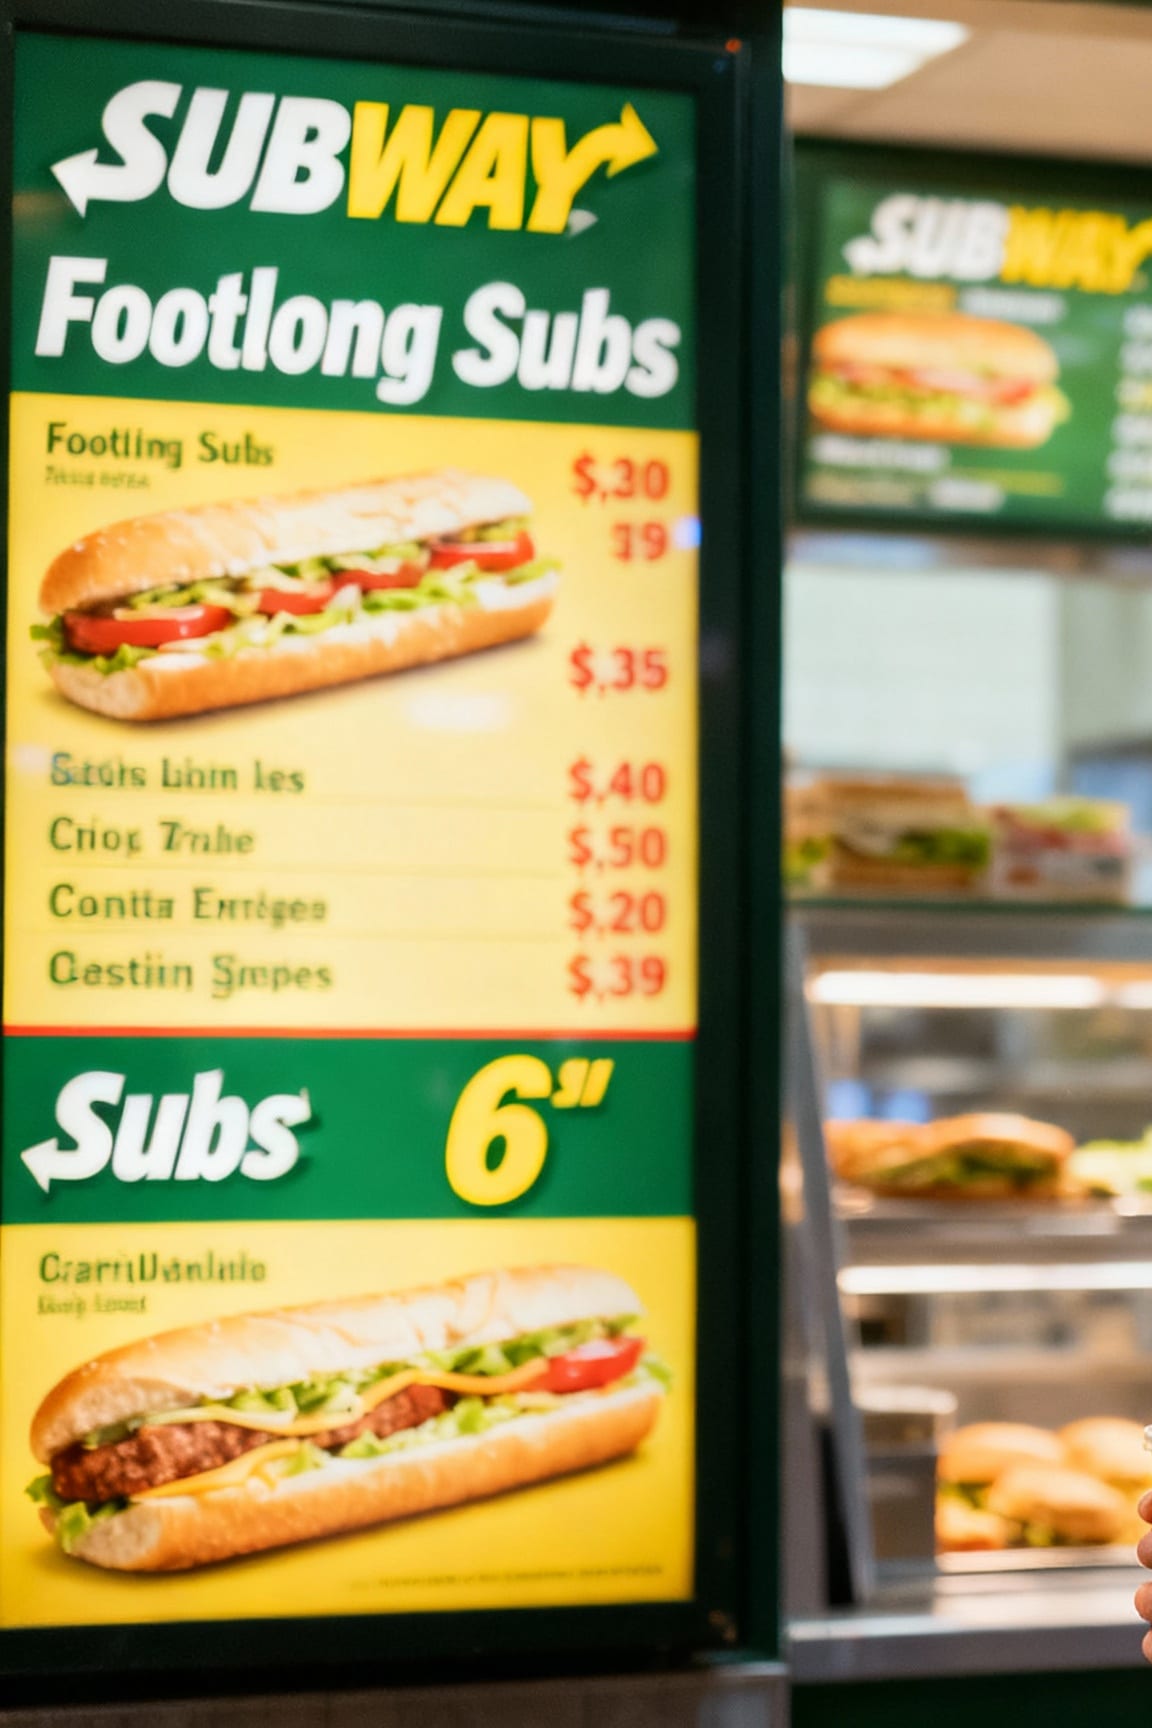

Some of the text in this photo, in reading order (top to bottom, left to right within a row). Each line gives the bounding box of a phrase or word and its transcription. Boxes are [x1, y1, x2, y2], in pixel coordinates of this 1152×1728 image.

[50, 80, 658, 234] SUBWAY
[34, 255, 682, 405] Footlong Subs
[197, 430, 275, 466] Subs
[20, 1068, 312, 1193] Subs
